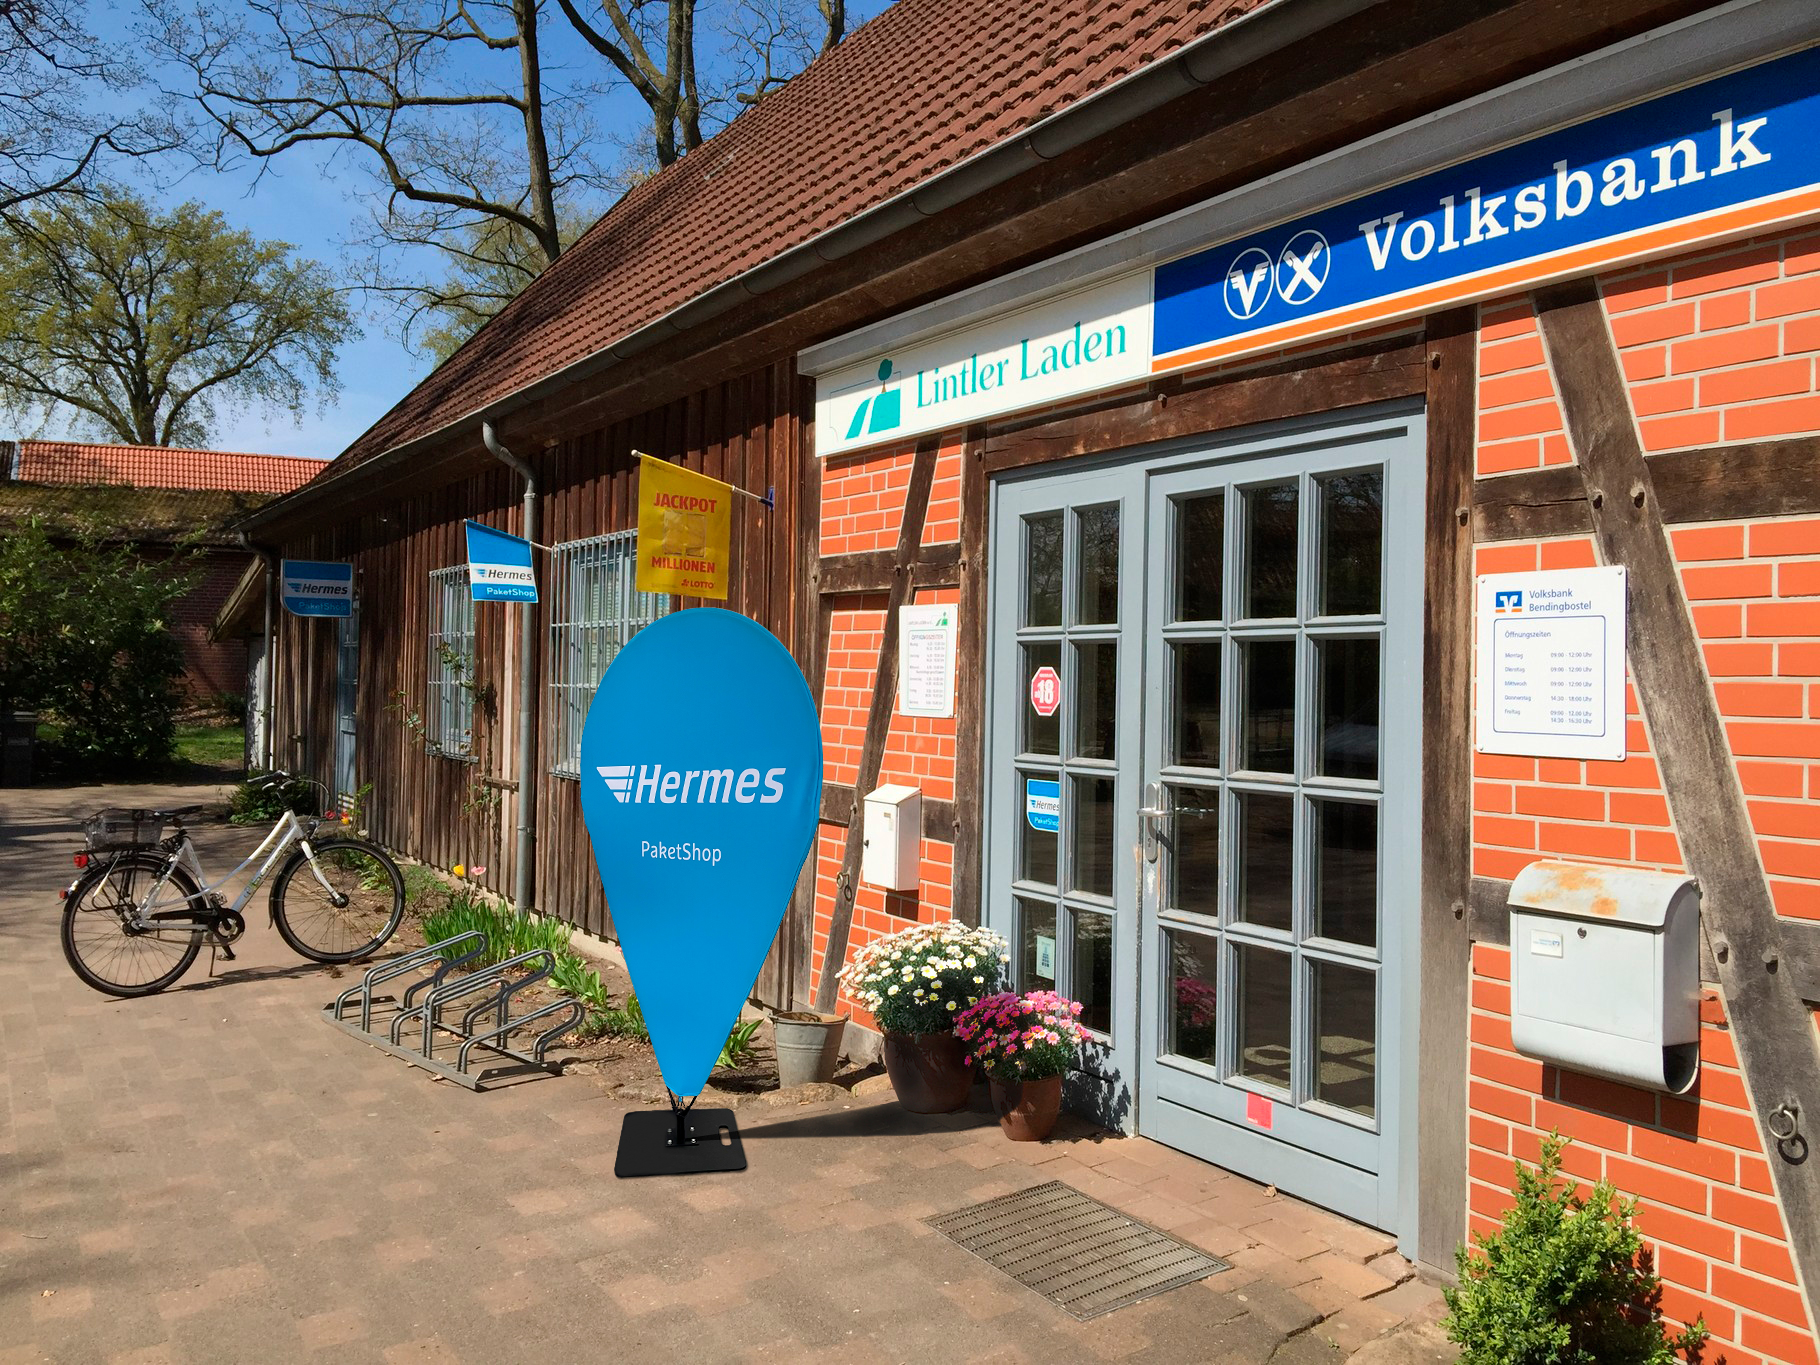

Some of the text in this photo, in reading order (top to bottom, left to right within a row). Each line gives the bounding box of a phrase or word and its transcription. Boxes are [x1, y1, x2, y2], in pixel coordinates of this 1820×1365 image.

[1359, 108, 1771, 271] Volksbank
[916, 321, 1127, 409] Lintler Laden
[653, 492, 717, 513] JACKPOT
[652, 556, 716, 573] MILLIONEN
[488, 569, 532, 581] Hermes
[302, 583, 348, 595] Hermes
[689, 580, 714, 589] LOTTO
[486, 586, 536, 598] PaketShop
[1529, 588, 1573, 599] Volksbank
[298, 601, 347, 612] PaketShop
[1529, 601, 1592, 613] Bendingbostel
[1504, 629, 1552, 640] Öffnungszeiten
[1037, 679, 1055, 705] 18
[634, 764, 787, 804] Hermes
[1036, 800, 1060, 811] Hermes
[641, 840, 722, 867] PaketShop
